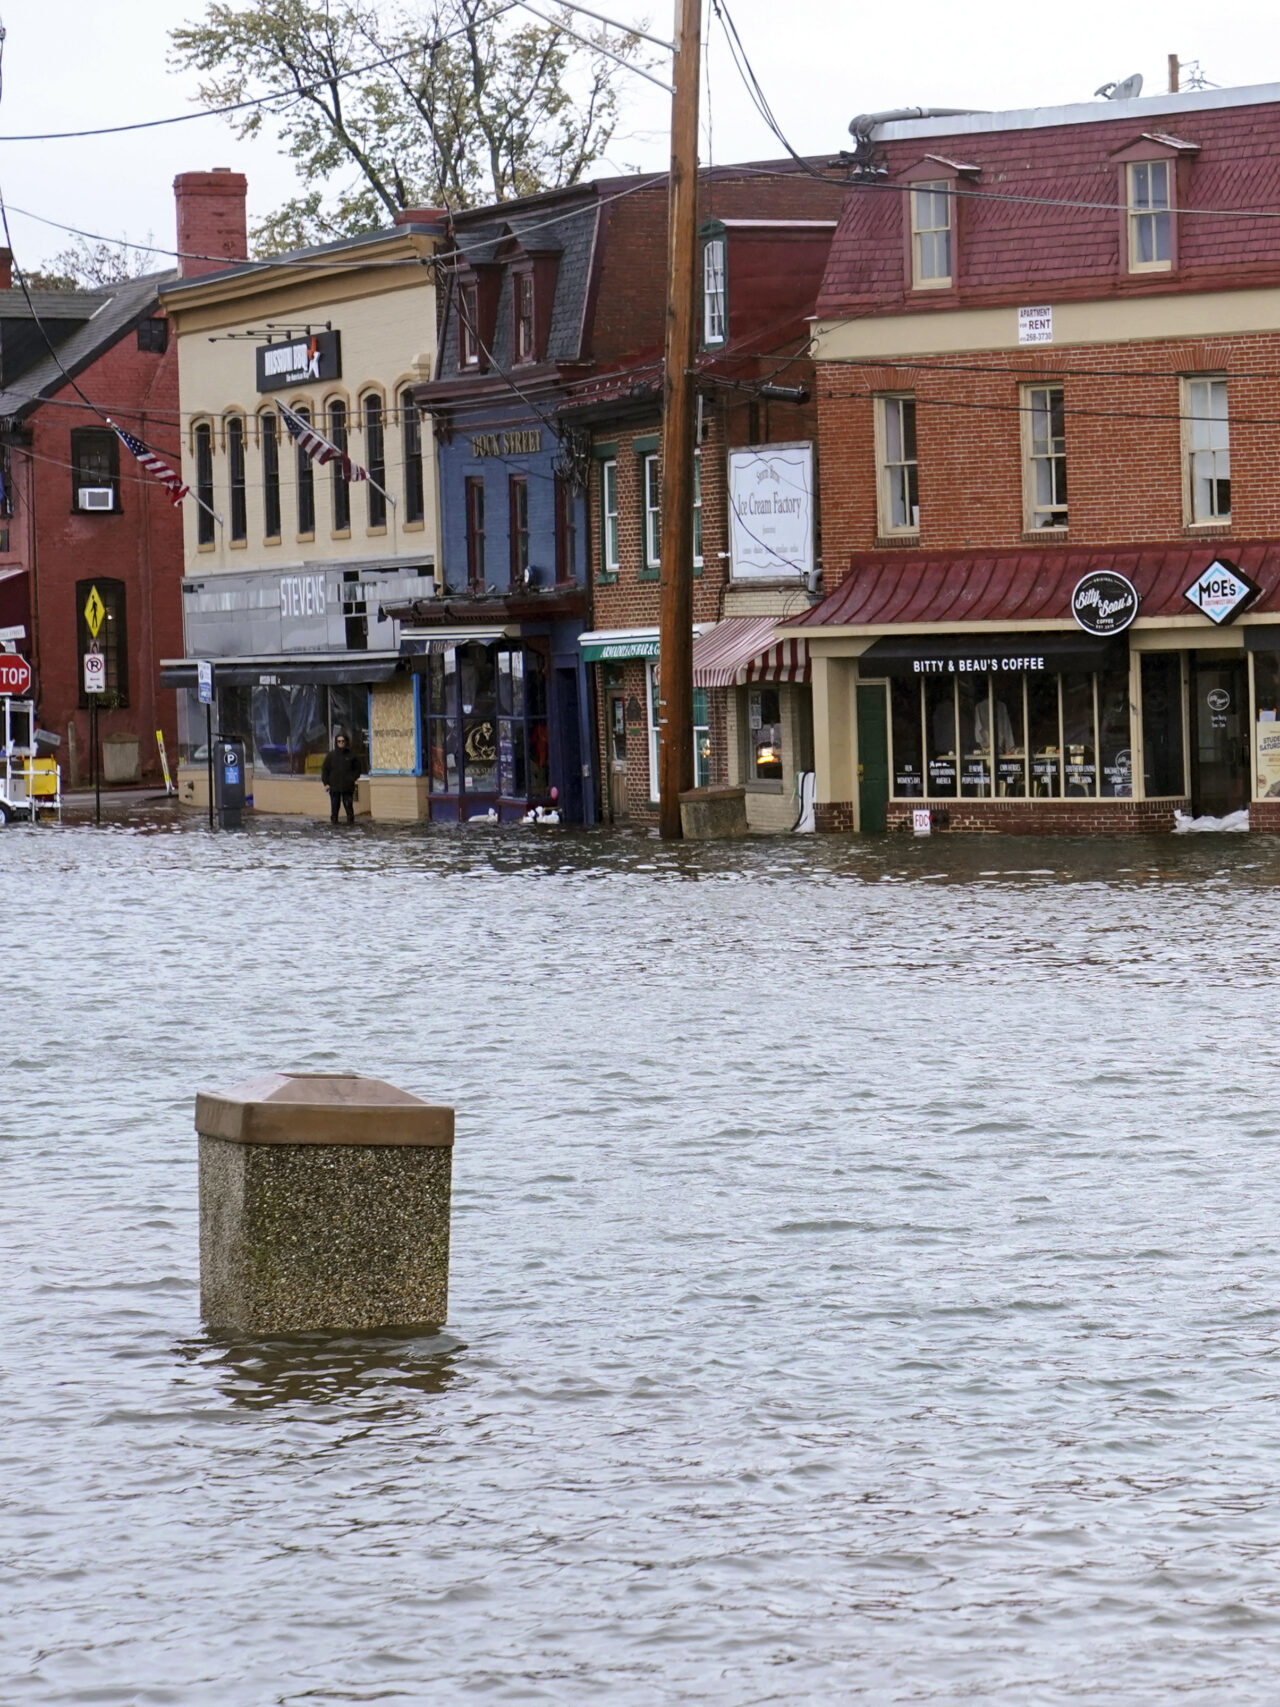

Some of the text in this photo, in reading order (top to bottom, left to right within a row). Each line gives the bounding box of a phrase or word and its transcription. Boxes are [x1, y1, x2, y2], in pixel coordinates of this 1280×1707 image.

[1020, 308, 1050, 317] APARTMENT
[1029, 319, 1050, 330] RENT
[472, 429, 541, 457] DOCK STREET
[737, 491, 802, 520] Ice Cream Factory
[280, 575, 326, 617] STEVENS
[1099, 592, 1133, 618] Beau's
[913, 658, 1045, 672] BITTY & BEAU'S COFFEE
[915, 814, 929, 827] FDC
